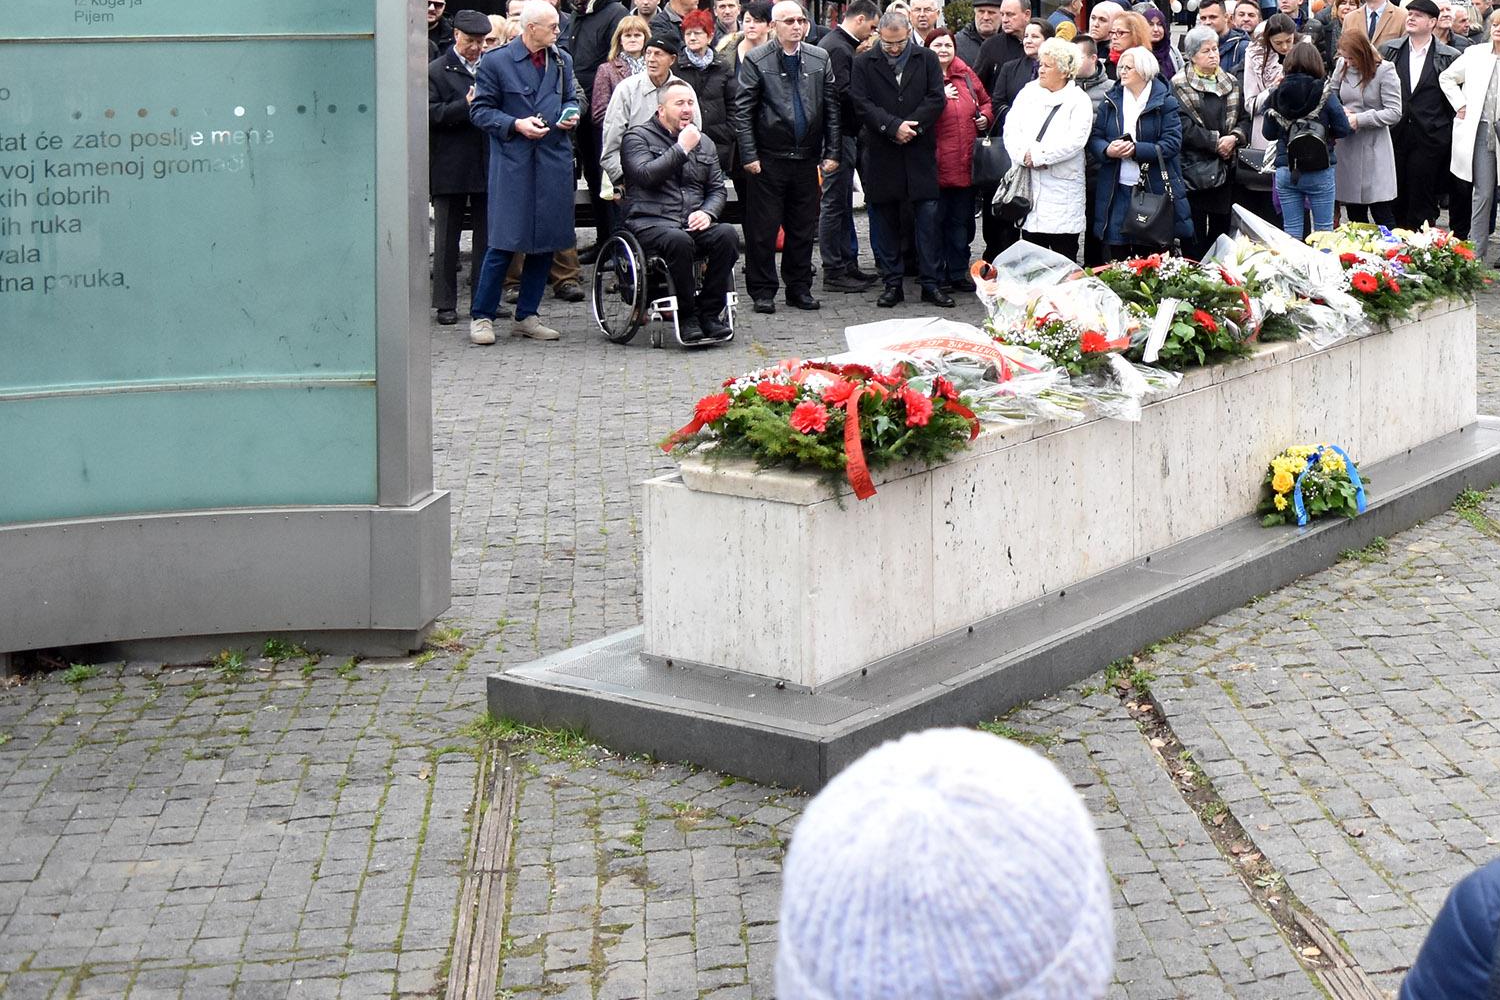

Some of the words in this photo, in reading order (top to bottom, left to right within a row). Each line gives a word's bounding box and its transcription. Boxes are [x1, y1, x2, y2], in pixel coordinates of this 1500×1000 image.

[74, 10, 114, 25] Pijem
[35, 130, 63, 150] će
[72, 131, 122, 149] zato
[130, 128, 204, 151] poslije
[211, 128, 275, 146] mene
[44, 156, 145, 180] kamenoj
[36, 186, 111, 207] dobrih
[1, 217, 21, 236] ih
[30, 215, 82, 234] ruka
[43, 268, 130, 294] poruka.
